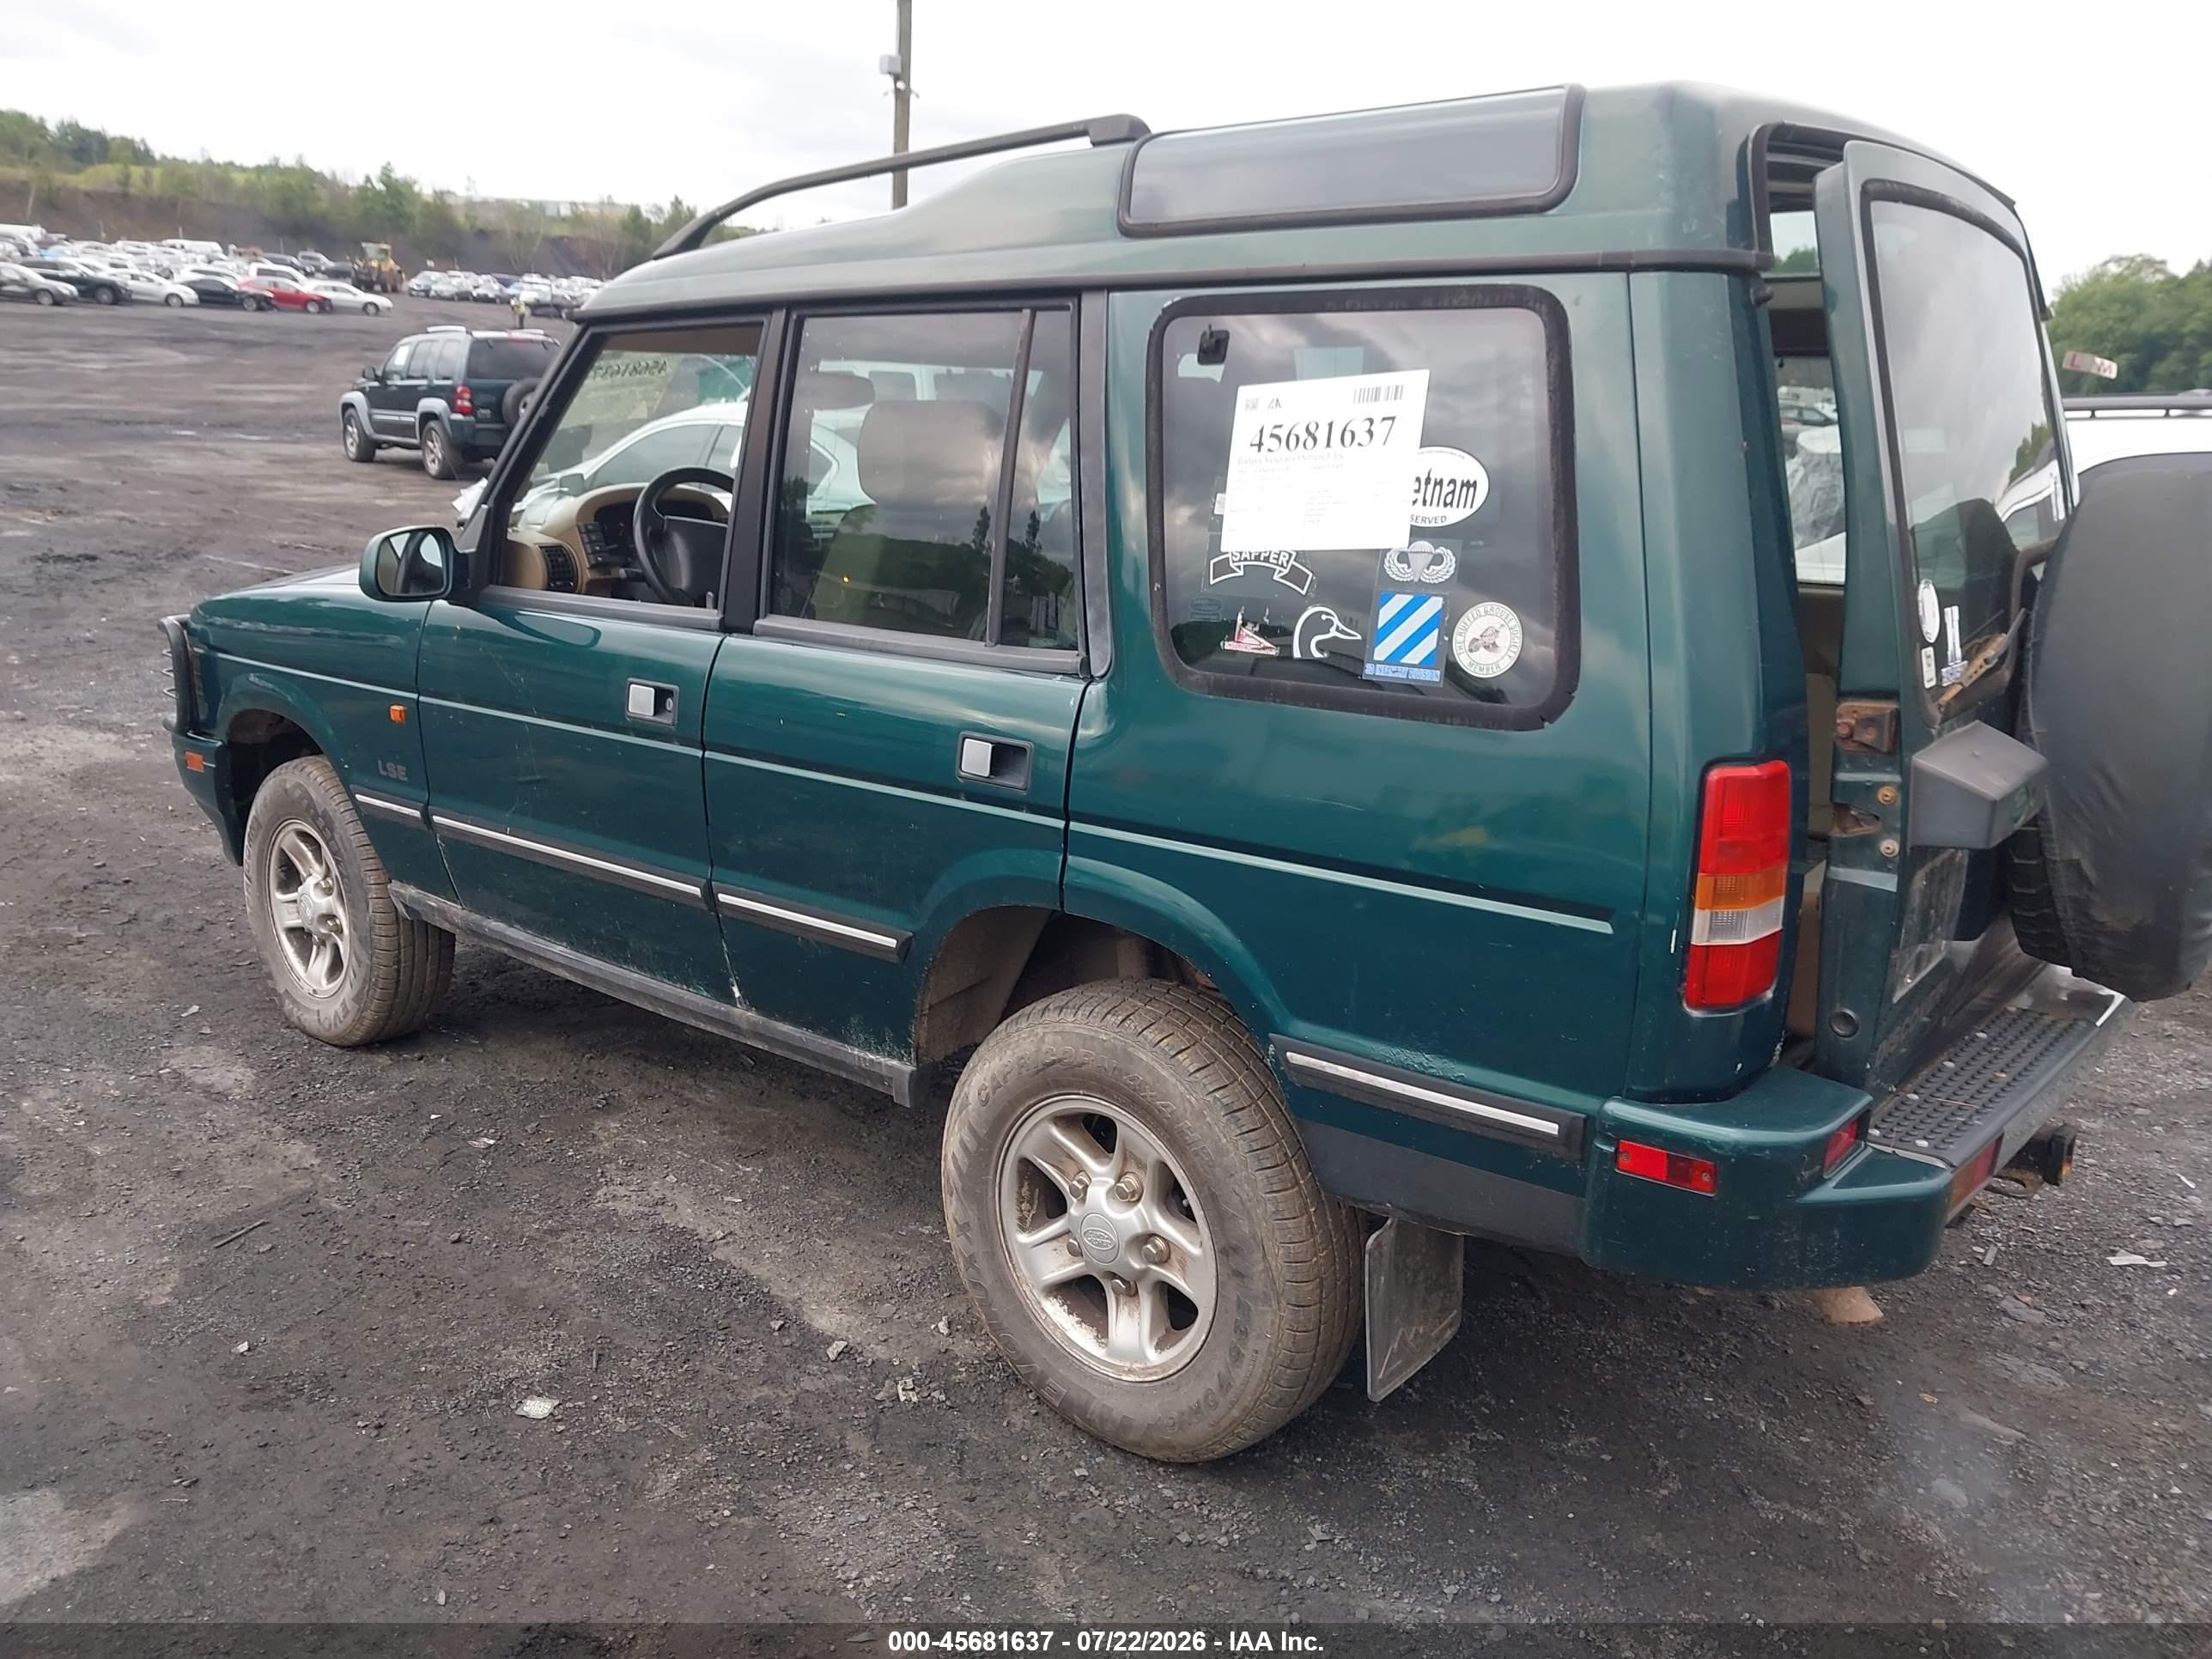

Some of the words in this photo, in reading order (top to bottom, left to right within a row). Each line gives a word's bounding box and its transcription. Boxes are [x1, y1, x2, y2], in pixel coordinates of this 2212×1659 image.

[1250, 415, 1397, 453] 45681637
[1411, 466, 1477, 508] etnam
[1409, 514, 1447, 525] SERVED
[1232, 550, 1290, 568] SAPPER
[378, 759, 409, 781] LSE
